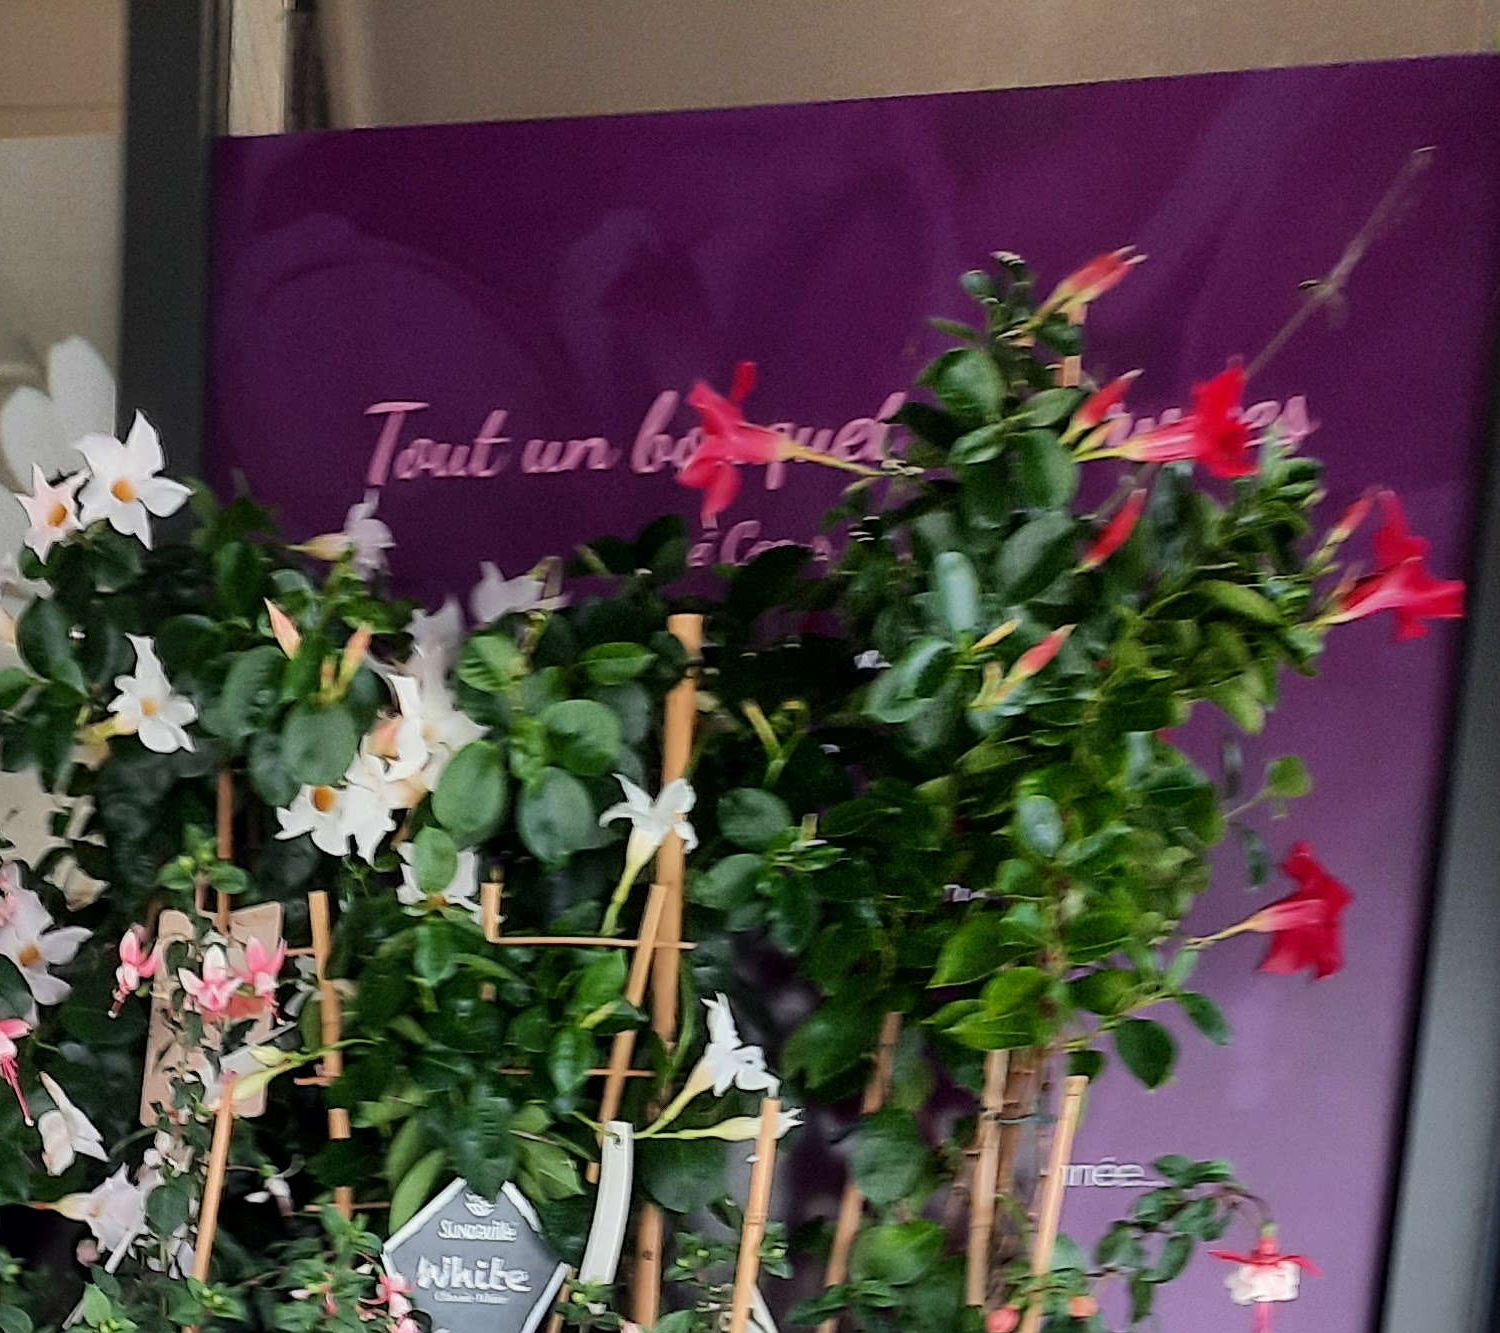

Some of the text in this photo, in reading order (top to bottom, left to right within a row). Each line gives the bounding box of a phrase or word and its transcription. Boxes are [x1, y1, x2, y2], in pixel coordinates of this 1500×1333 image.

[364, 401, 512, 487] Tout
[521, 437, 622, 474] un
[415, 1255, 533, 1293] White
